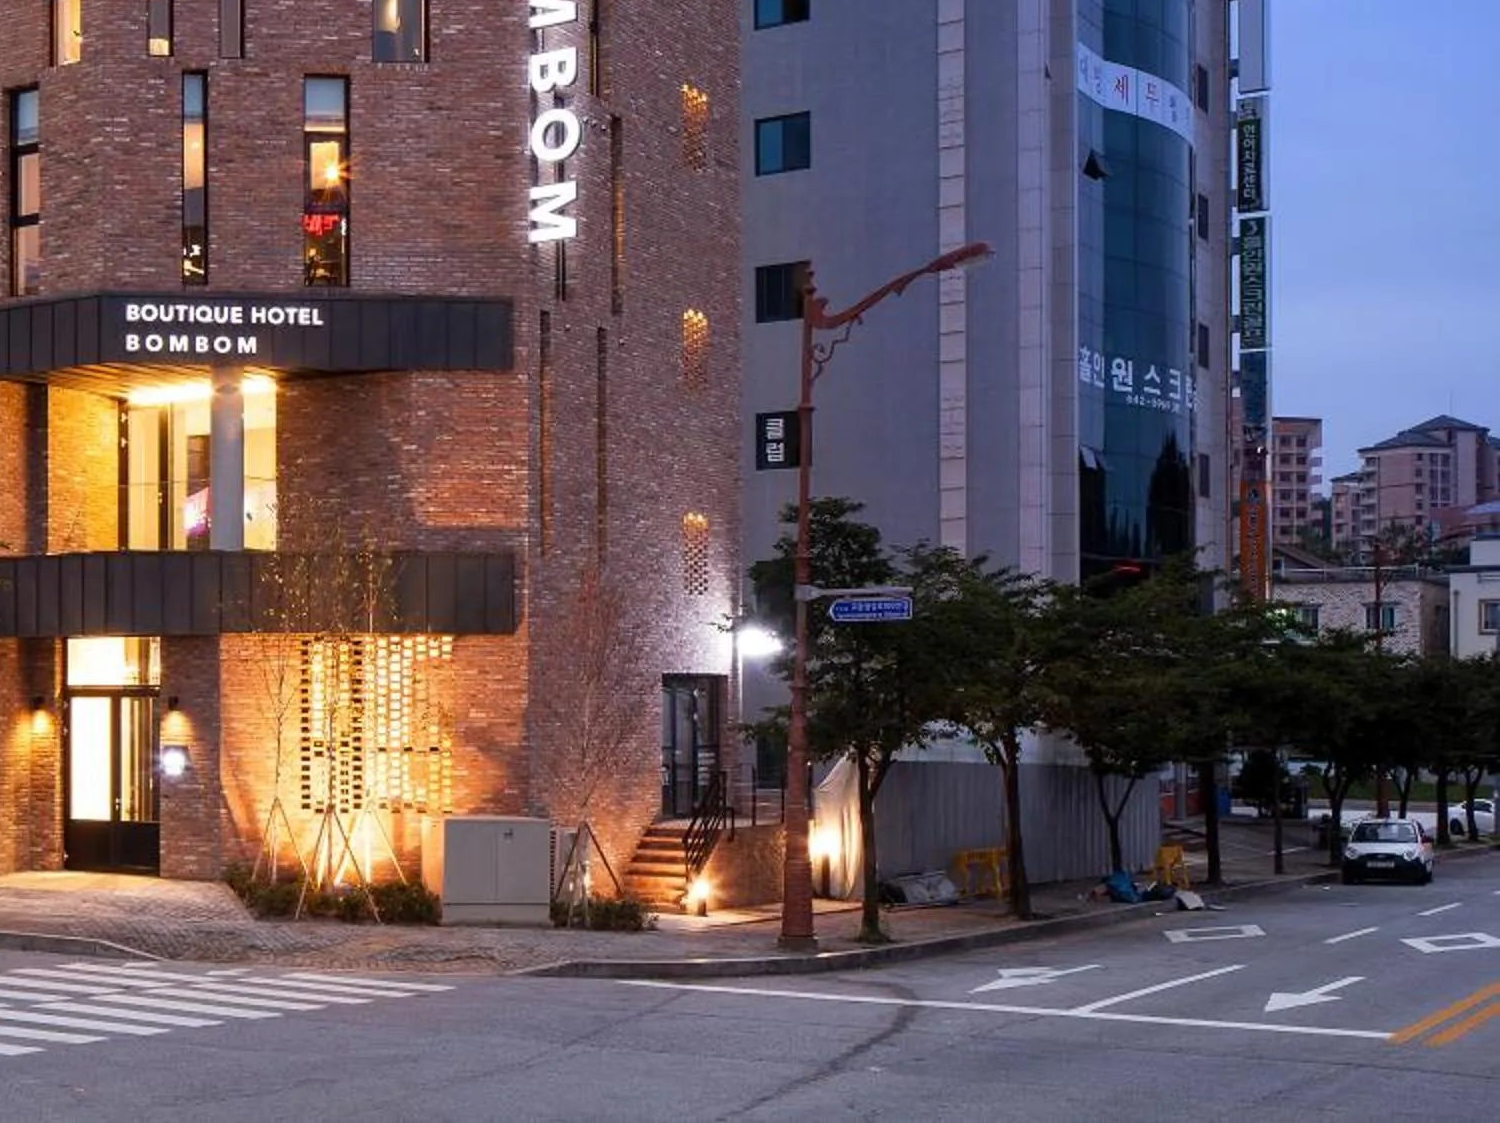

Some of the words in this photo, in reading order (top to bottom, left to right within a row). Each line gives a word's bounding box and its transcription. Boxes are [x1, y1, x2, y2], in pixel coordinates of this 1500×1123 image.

[125, 303, 243, 324] BOUTIQUE
[251, 306, 324, 326] HOTEL
[125, 334, 258, 354] BOMBOM
